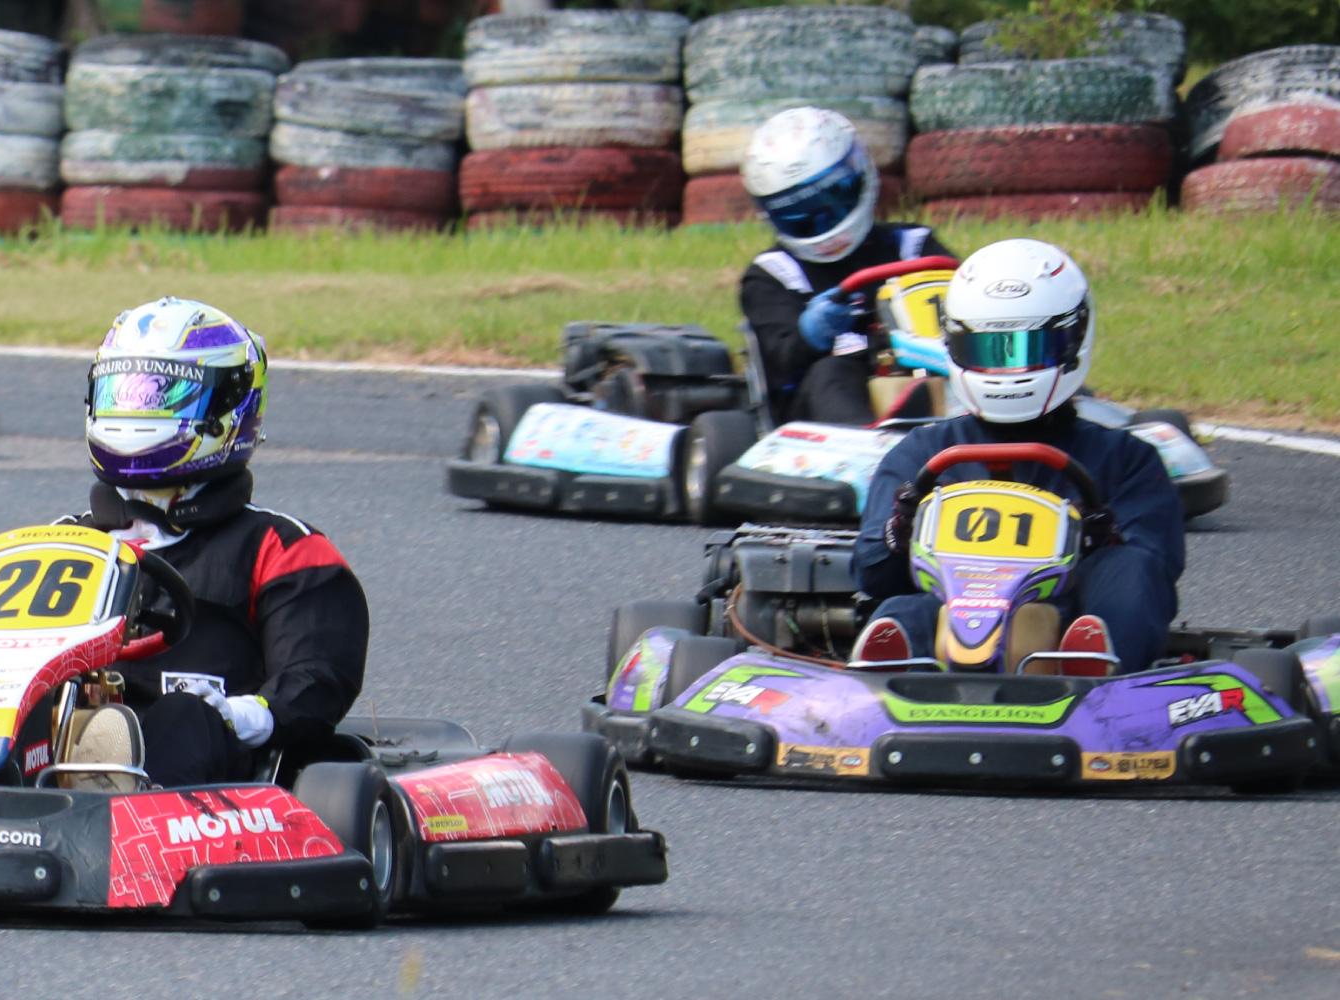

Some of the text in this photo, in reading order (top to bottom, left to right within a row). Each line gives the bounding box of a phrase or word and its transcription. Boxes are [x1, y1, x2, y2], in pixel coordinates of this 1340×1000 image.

[986, 282, 1027, 294] Arai
[134, 360, 204, 381] YUNAHAN
[954, 507, 1034, 546] 01
[910, 708, 1045, 719] EVANGELION
[25, 744, 49, 772] MOTUL
[471, 769, 554, 808] MOTUL
[167, 808, 284, 844] MOTUL
